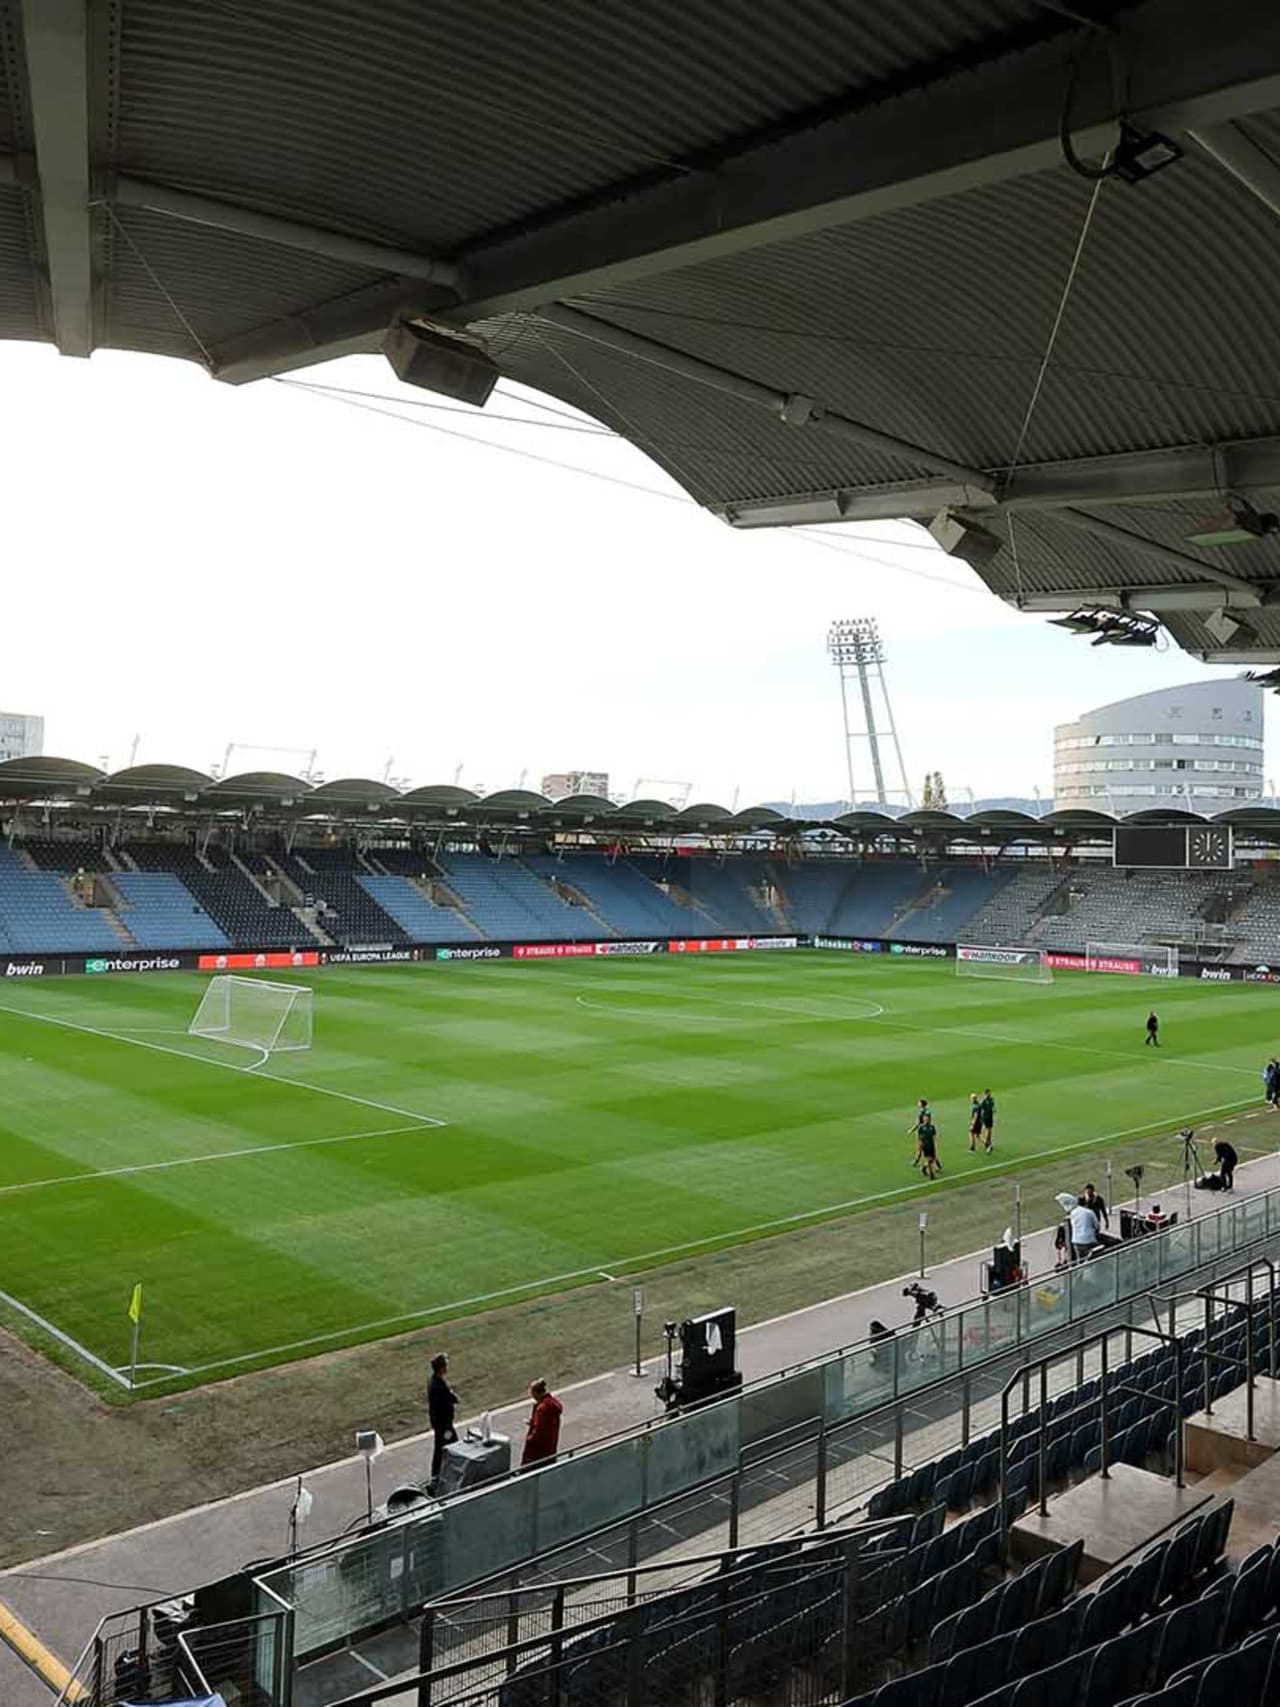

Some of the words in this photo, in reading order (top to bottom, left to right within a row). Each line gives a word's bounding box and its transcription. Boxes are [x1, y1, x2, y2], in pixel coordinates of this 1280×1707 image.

[440, 947, 501, 960] enterprise
[6, 961, 44, 977] bwin
[92, 956, 180, 972] enterprise
[1201, 967, 1232, 981] bwin
